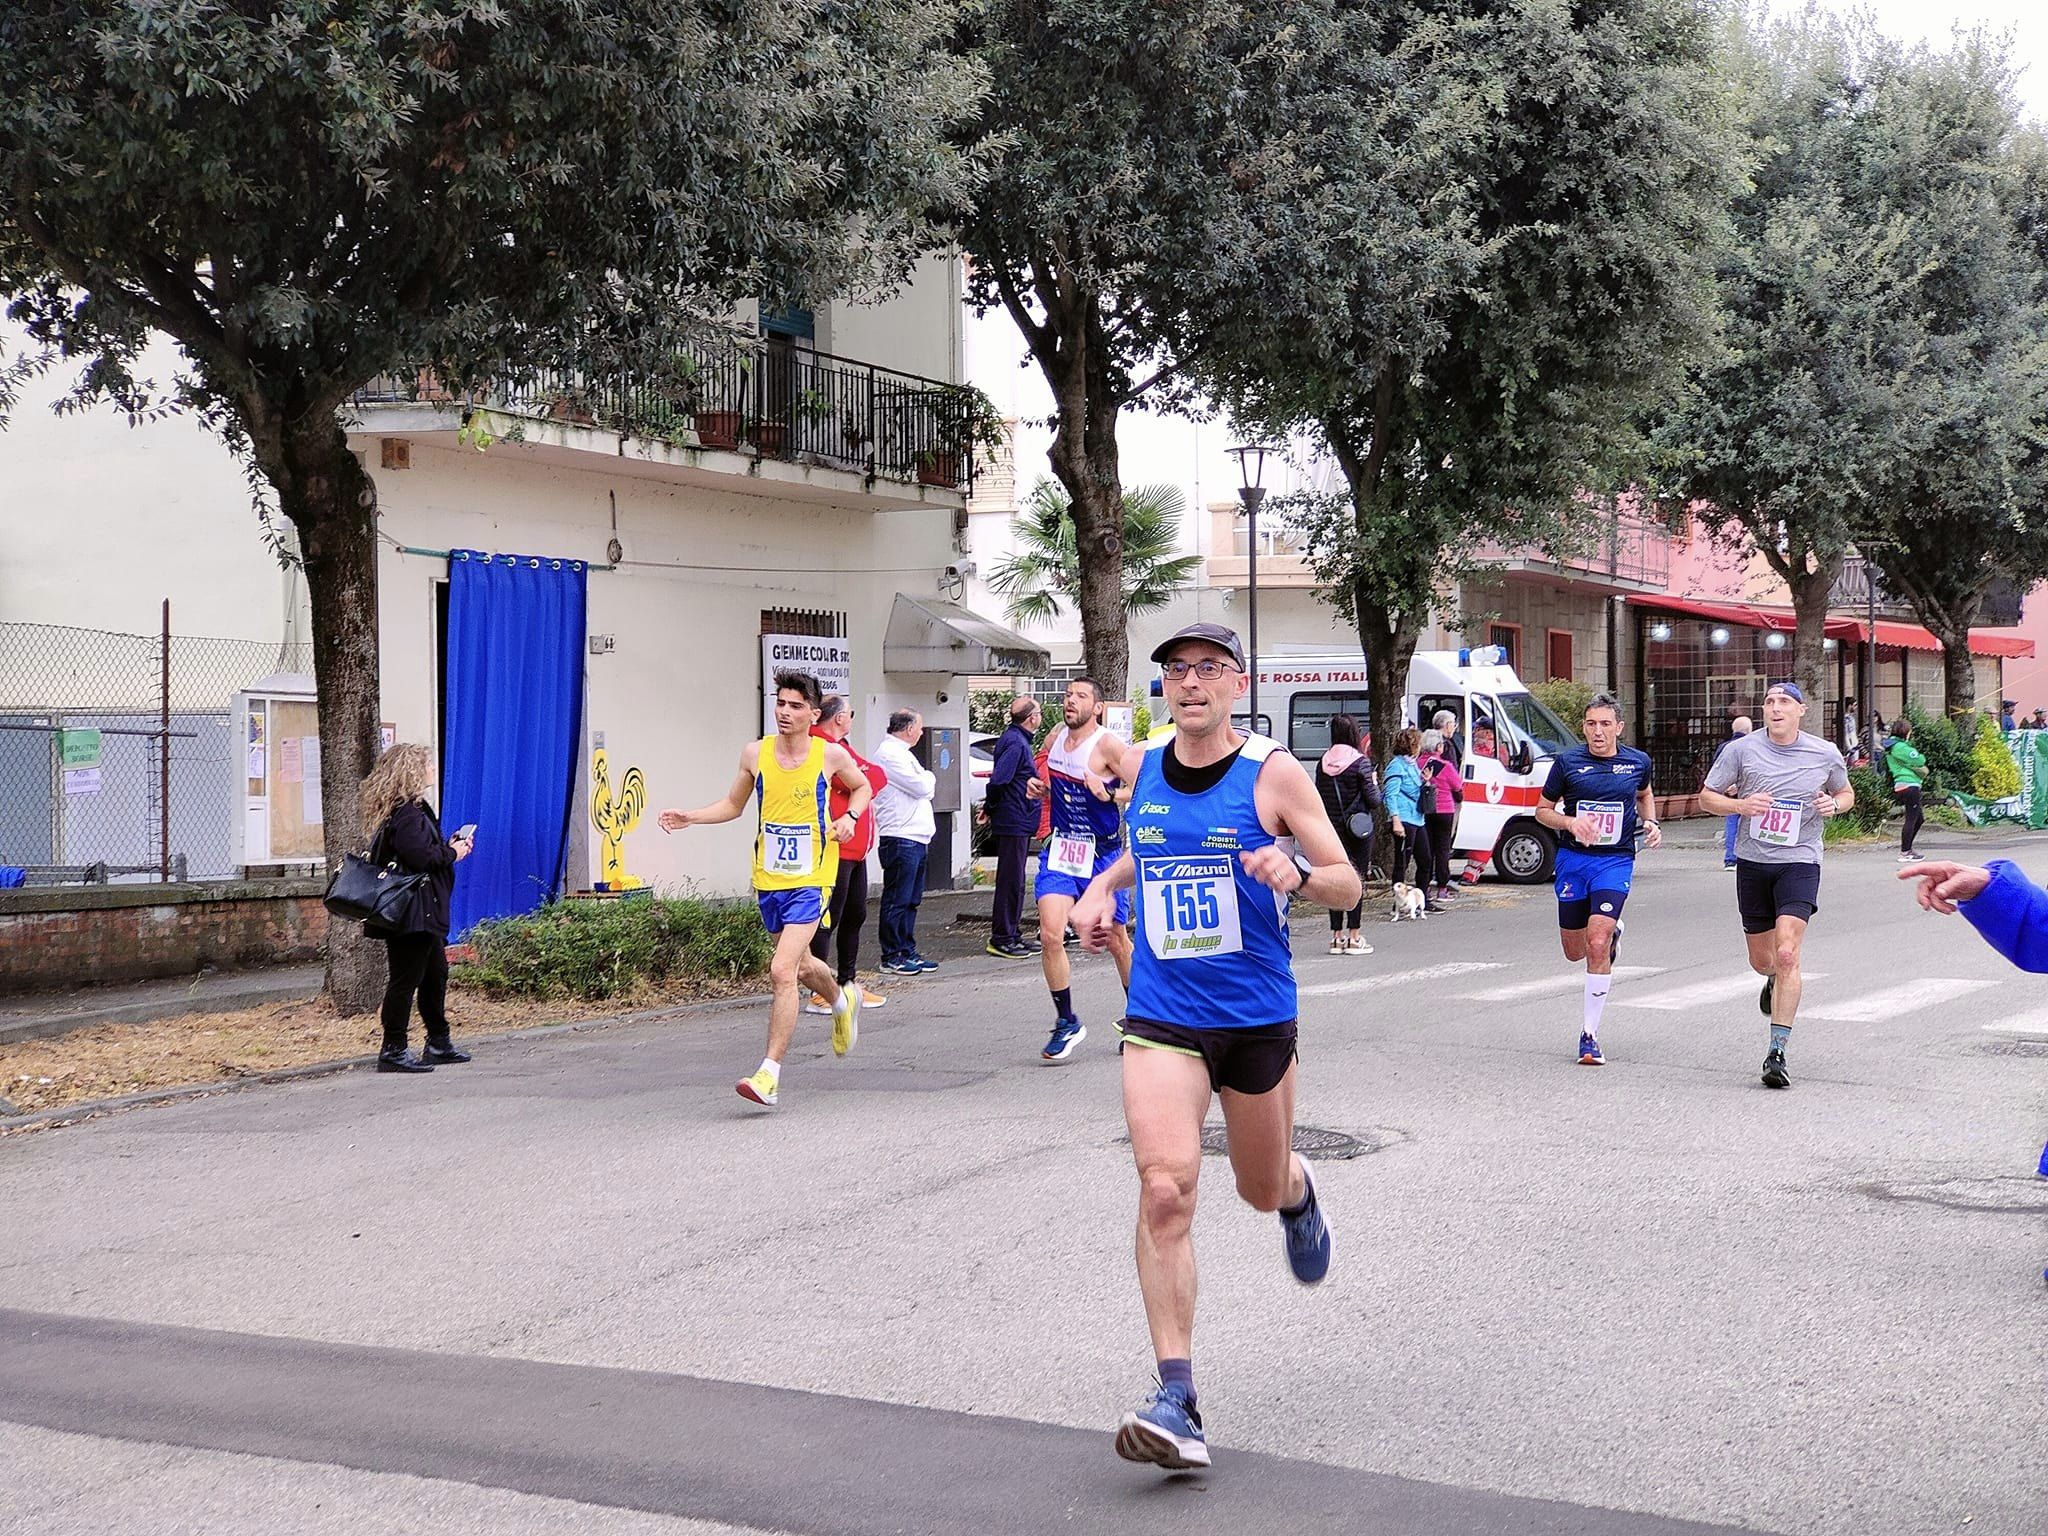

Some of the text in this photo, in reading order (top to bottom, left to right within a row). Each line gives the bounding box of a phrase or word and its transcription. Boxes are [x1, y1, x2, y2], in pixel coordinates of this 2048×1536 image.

[1273, 672, 1321, 683] ROSSA
[1327, 671, 1365, 682] ITALI
[1147, 804, 1170, 814] asics
[1760, 810, 1792, 833] 282
[778, 837, 798, 861] 23
[1059, 841, 1087, 865] 269
[1201, 841, 1243, 849] COTIGNOLA
[1161, 881, 1219, 932] 155
